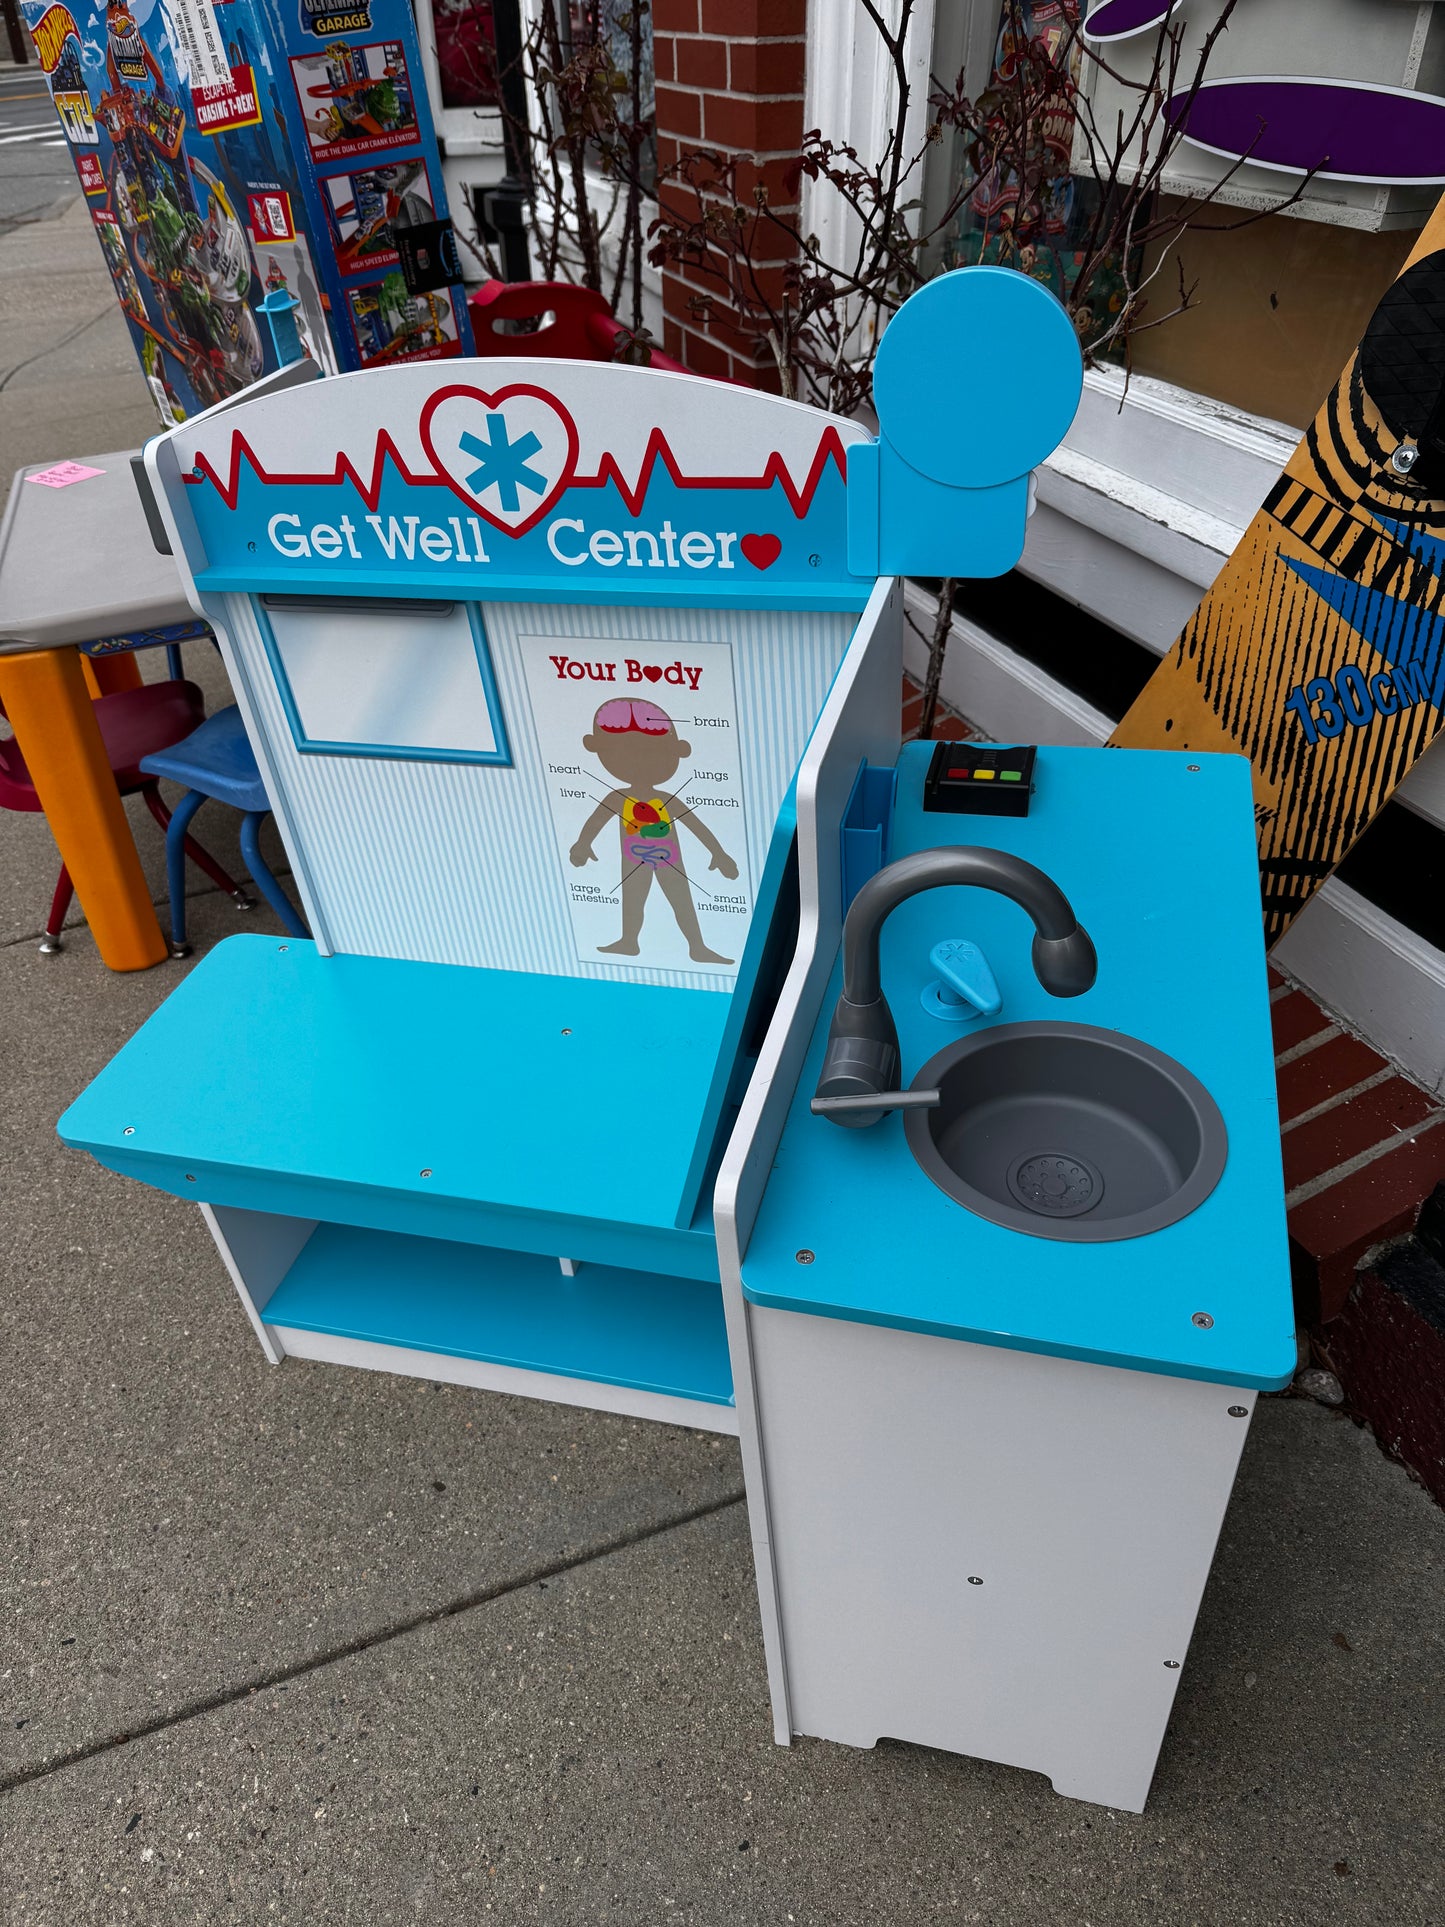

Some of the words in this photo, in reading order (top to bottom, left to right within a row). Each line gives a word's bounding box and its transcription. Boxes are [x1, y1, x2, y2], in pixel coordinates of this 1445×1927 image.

[316, 12, 368, 33] GARAGE
[120, 62, 145, 76] GARAGE
[202, 84, 225, 101] ESCAPE
[197, 100, 229, 124] CHASING
[227, 93, 256, 116] T-REX!
[315, 147, 329, 159] RIDE
[330, 145, 342, 156] THE
[342, 142, 357, 153] DUAL
[357, 139, 370, 150] CAR
[369, 136, 389, 148] CRANK
[267, 513, 362, 559] Get
[365, 515, 490, 563] Well
[547, 518, 737, 569] Center
[549, 656, 617, 682] Your
[693, 716, 730, 728] brain
[548, 763, 582, 775] heart
[693, 769, 729, 781] lungs
[560, 788, 587, 799] liver
[685, 796, 740, 808] stomach
[570, 882, 601, 894] large
[572, 892, 620, 905] intestine
[713, 893, 747, 904] small
[697, 902, 747, 914] intestine
